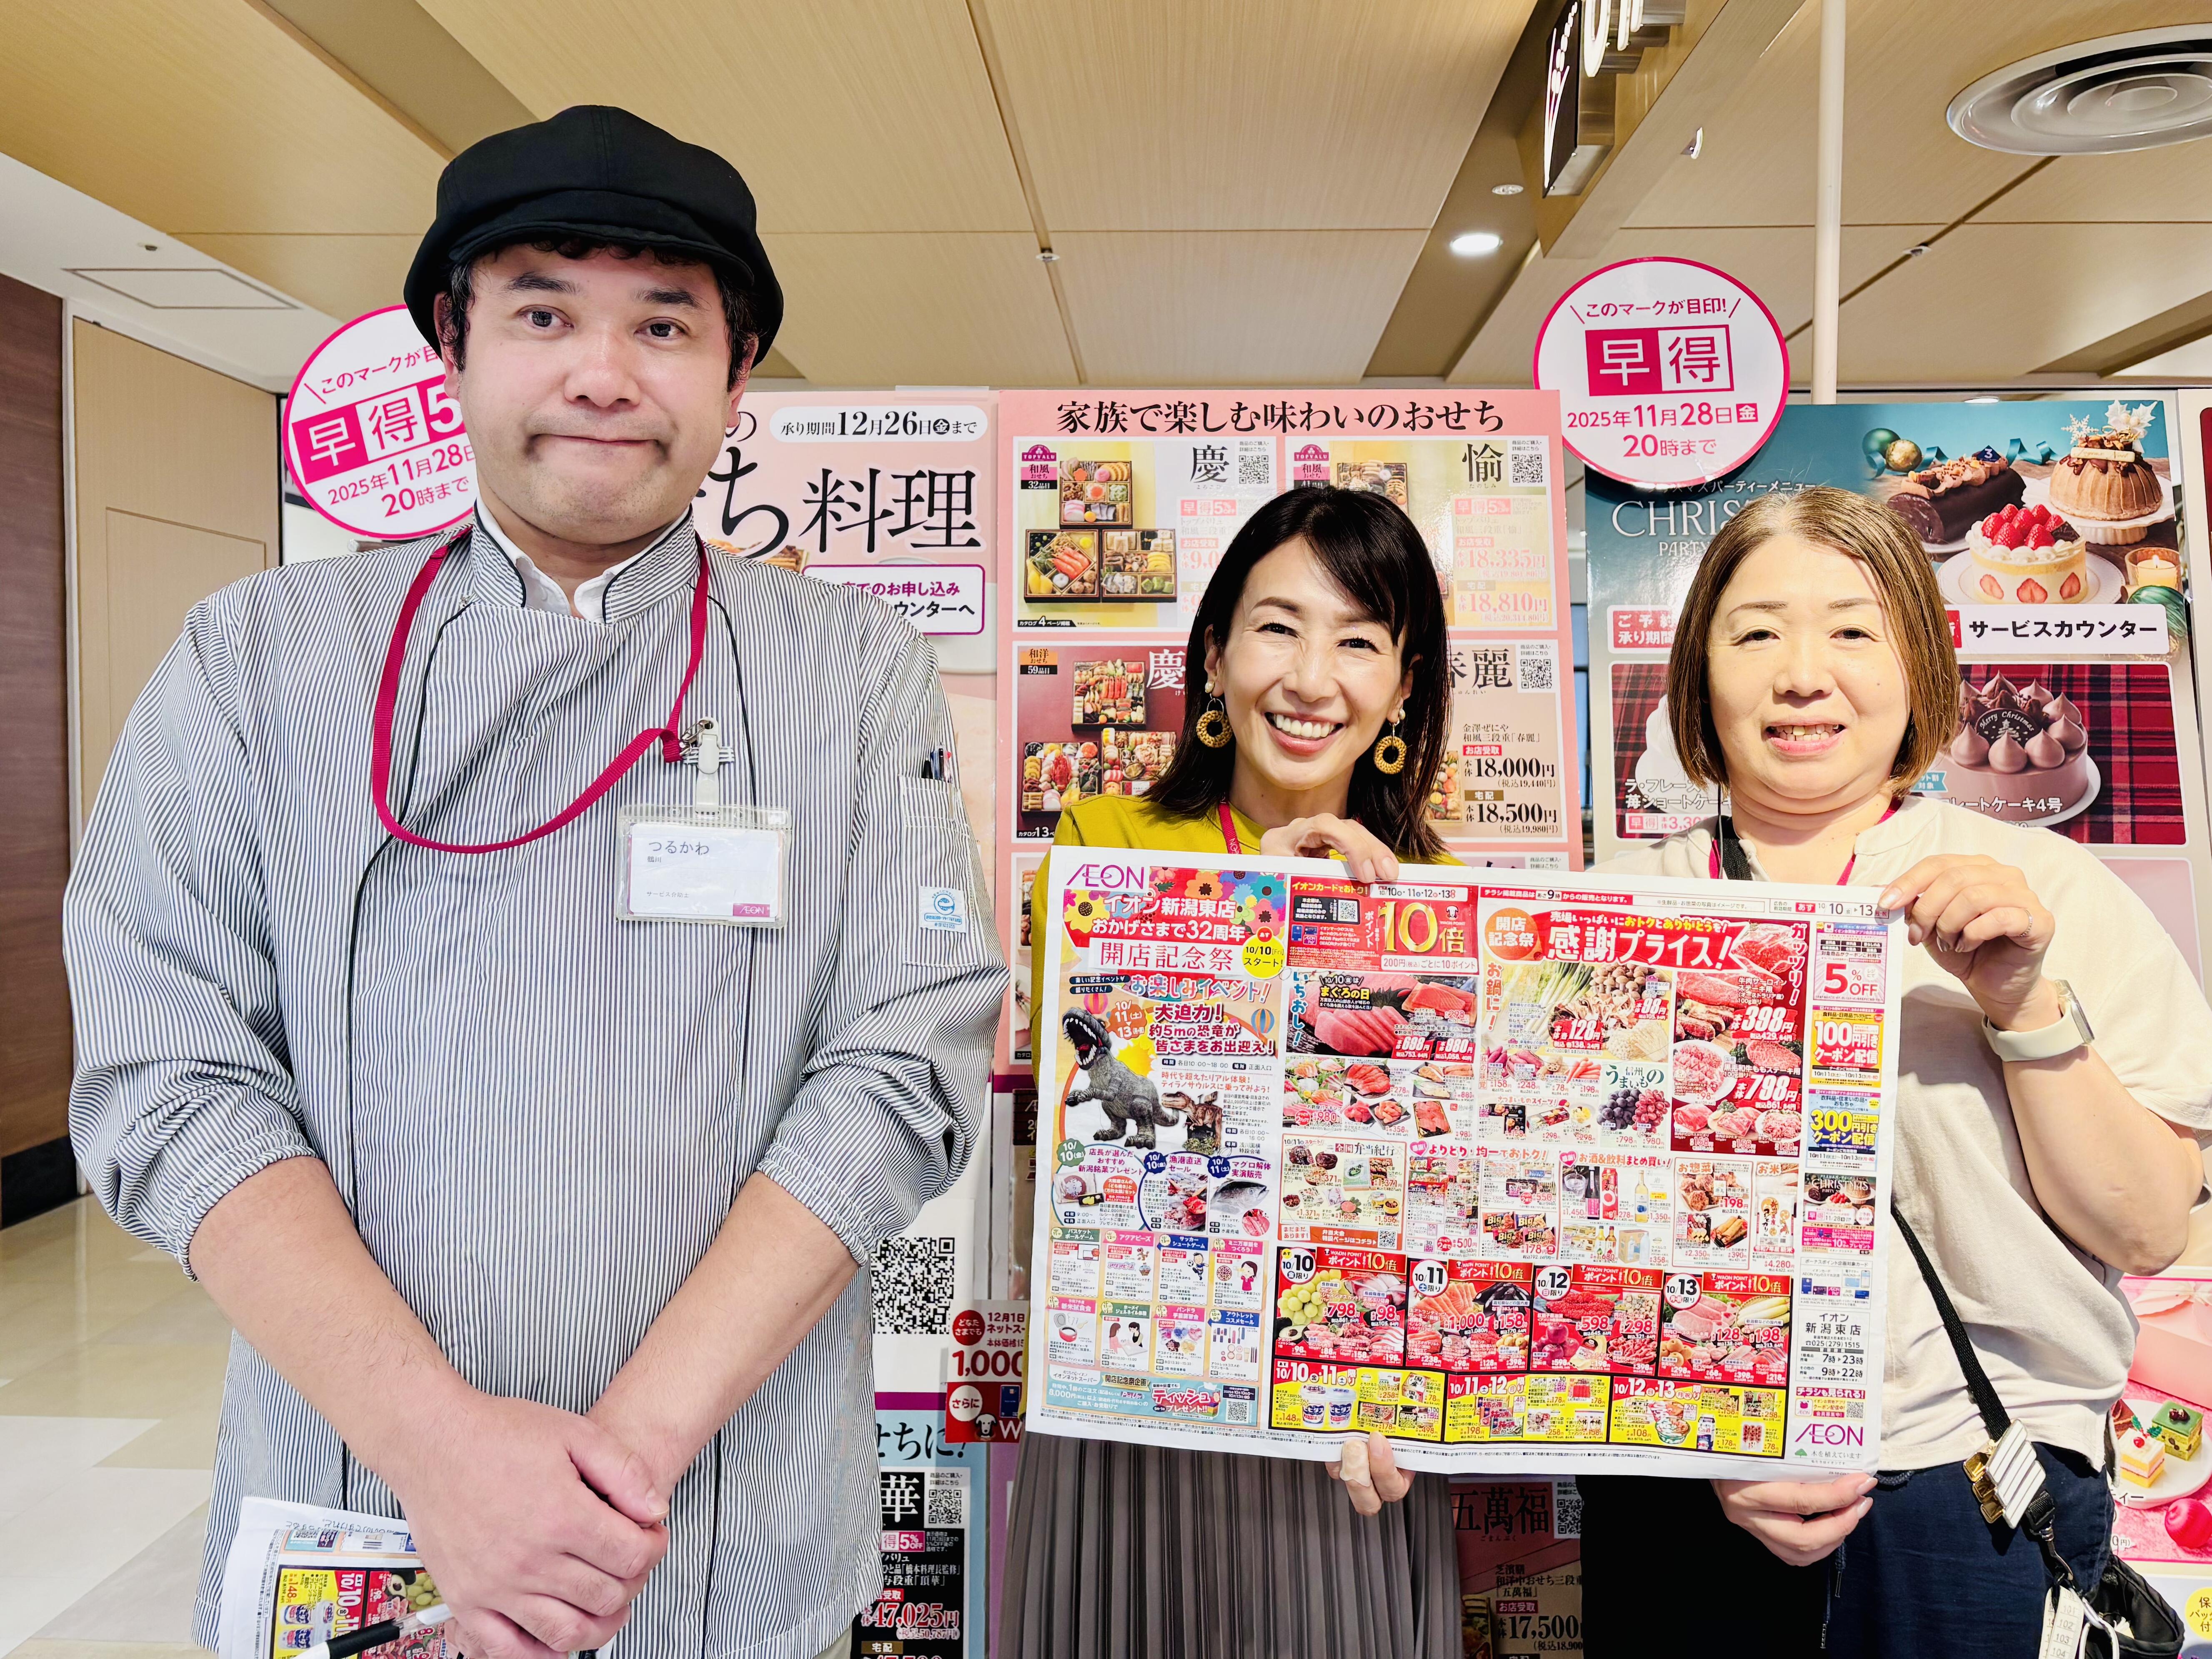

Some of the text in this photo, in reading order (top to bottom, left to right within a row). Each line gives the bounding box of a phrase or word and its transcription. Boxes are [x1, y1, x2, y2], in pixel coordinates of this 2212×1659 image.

[1584, 298, 1728, 318] このマークが目印!
[1599, 336, 1721, 387] 早得
[1057, 401, 1504, 433] 家族で楽しむ味わいのおせち
[1623, 434, 1716, 458] 20時まで
[1029, 464, 1049, 473] 和風
[1190, 445, 1230, 483] 慶
[382, 476, 468, 517] 20時まで
[1183, 539, 1217, 548] お店受取
[1969, 620, 2157, 638] サービスカウンター
[1028, 648, 1049, 658] 和洋
[1980, 711, 2035, 732] Merry Christmas
[1465, 746, 1499, 755] お店受取
[1475, 758, 1555, 778] 18,000円
[1475, 791, 1494, 800] 宅配
[1477, 803, 1557, 823] 18,500円
[649, 841, 709, 855] つるかわ
[1104, 894, 1236, 919] イオン新潟東店
[1092, 918, 1246, 942] おかげさまで32周年
[1365, 911, 1374, 948] ポイント
[1496, 916, 1527, 932] 開店
[1440, 927, 1464, 953] 倍
[1488, 932, 1534, 948] 記念祭
[1548, 925, 1735, 970] 感謝プライス!
[1101, 942, 1234, 971] 開店記念祭
[1244, 958, 1284, 968] スタート!
[1788, 923, 1808, 1006] ガッツリ!
[1738, 977, 1787, 986] 牛肉サーロイン
[1130, 973, 1272, 1003] お楽しみイベント!
[1320, 987, 1370, 1000] まぐろの日
[1738, 985, 1773, 993] ステーキ用
[1486, 962, 1502, 1031] お鍋に!
[1155, 1003, 1223, 1022] 大迫力!
[1291, 971, 1308, 1046] いちおし!
[1149, 1024, 1240, 1038] 約5mの恐竜が
[1156, 1039, 1275, 1055] 皆さまをお出迎え!
[1814, 1048, 1878, 1064] クーポン配信
[1724, 1064, 1801, 1075] 黒毛和牛ももステーキ用
[1161, 1071, 1250, 1083] 時代を超えたリアル体験!
[1161, 1080, 1270, 1093] ティラノサウルスに乗ってみよう!
[1497, 1096, 1559, 1105] さつまいものスイーツ!
[1813, 1131, 1875, 1146] クーポン配信
[1089, 1148, 1134, 1158] 店長が選んだ
[1097, 1157, 1125, 1166] おすすめ
[1169, 1155, 1202, 1165] 漁港直送
[1232, 1161, 1271, 1170] マグロ解体
[1579, 1153, 1671, 1167] お酒&飲料まとめ買い!
[1078, 1165, 1143, 1176] 新潟銘菓プレゼント
[1232, 1169, 1262, 1179] 実演販売
[1678, 1163, 1712, 1173] お惣菜
[1757, 1164, 1780, 1174] お米
[1811, 1178, 1869, 1191] CHRISTMAS
[1119, 1234, 1151, 1242] アクアビーズ
[1328, 1255, 1361, 1267] ポイント
[958, 1318, 979, 1326] どなた
[1819, 1313, 1849, 1323] イオン
[1805, 1323, 1861, 1336] 新潟東店
[1822, 1354, 1863, 1365] 7時 23時
[1053, 1373, 1098, 1383] イオンネットスーパー
[1822, 1367, 1863, 1378] 9時 22時
[1105, 1375, 1147, 1386] 開店記念祭企画
[1151, 1389, 1211, 1404] ティッシュ
[1797, 1387, 1865, 1399] チラシも見られる!
[952, 1398, 980, 1409] さらに
[1811, 1450, 1862, 1459] 木を植えています
[1451, 1486, 1549, 1535] 五萬福
[1499, 1602, 1535, 1612] お店受取
[2059, 1620, 2072, 1628] 102
[2056, 1634, 2069, 1644] 103
[871, 1643, 893, 1652] 宅配
[2052, 1648, 2065, 1656] 104
